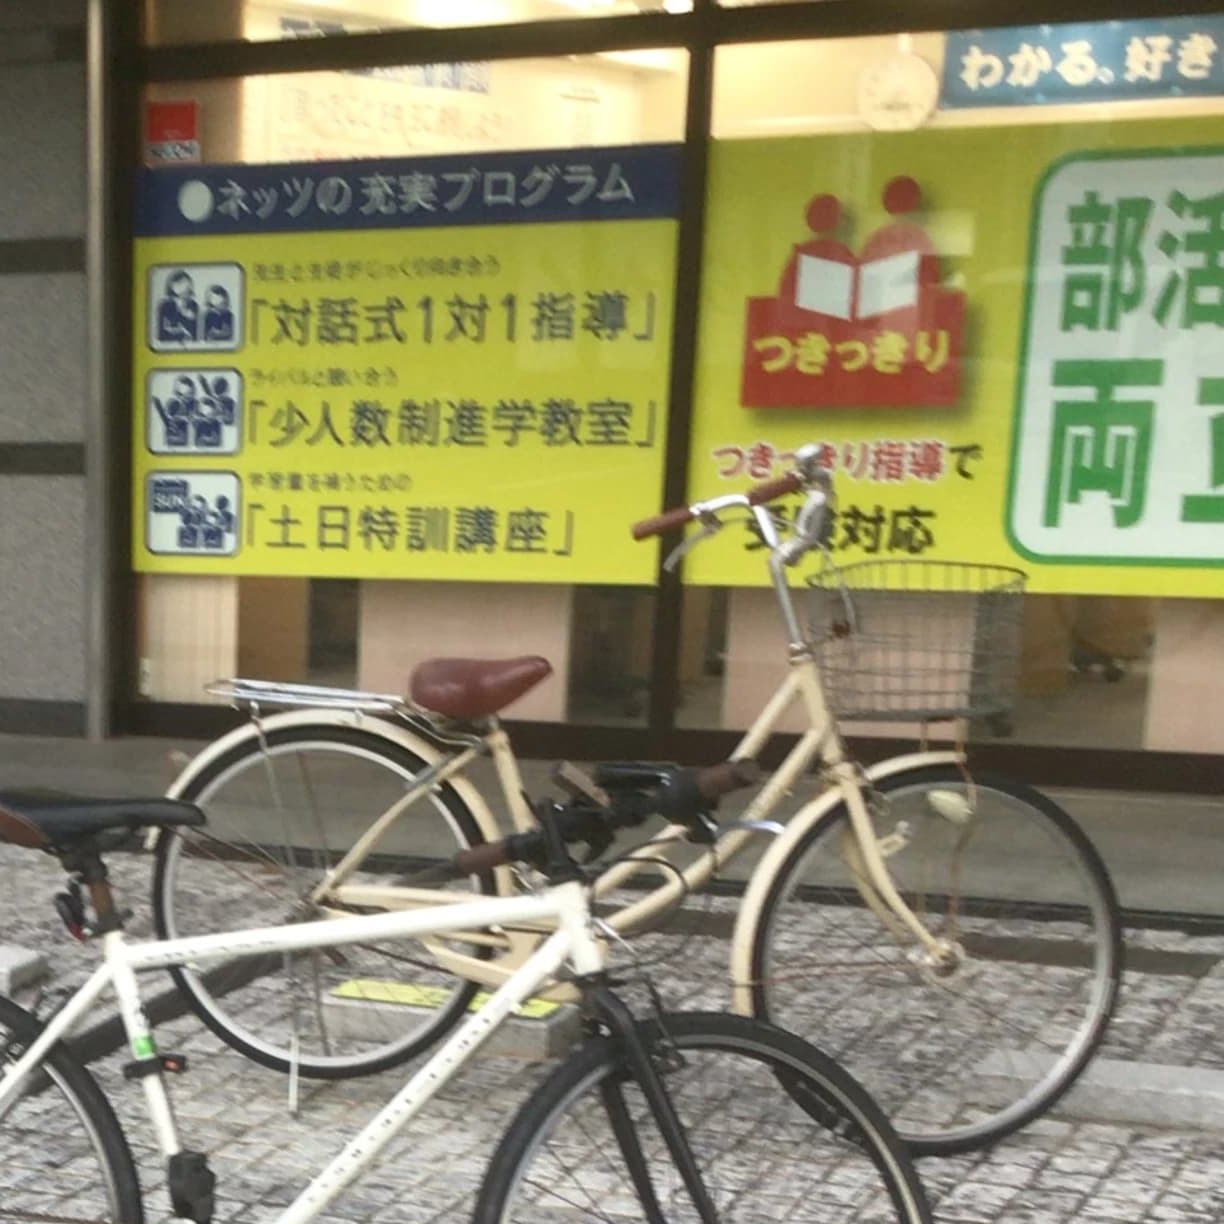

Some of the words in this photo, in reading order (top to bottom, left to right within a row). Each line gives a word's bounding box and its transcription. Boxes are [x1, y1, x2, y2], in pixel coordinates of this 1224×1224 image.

[218, 164, 634, 219] ネッツの充実プログラム
[249, 292, 655, 345] 「対話式1対1指導」
[753, 330, 949, 376] つきっきり
[246, 400, 656, 449] 「少人数制進学教室」
[246, 504, 575, 557] 「土日特訓講座」
[744, 505, 937, 553] 対応
